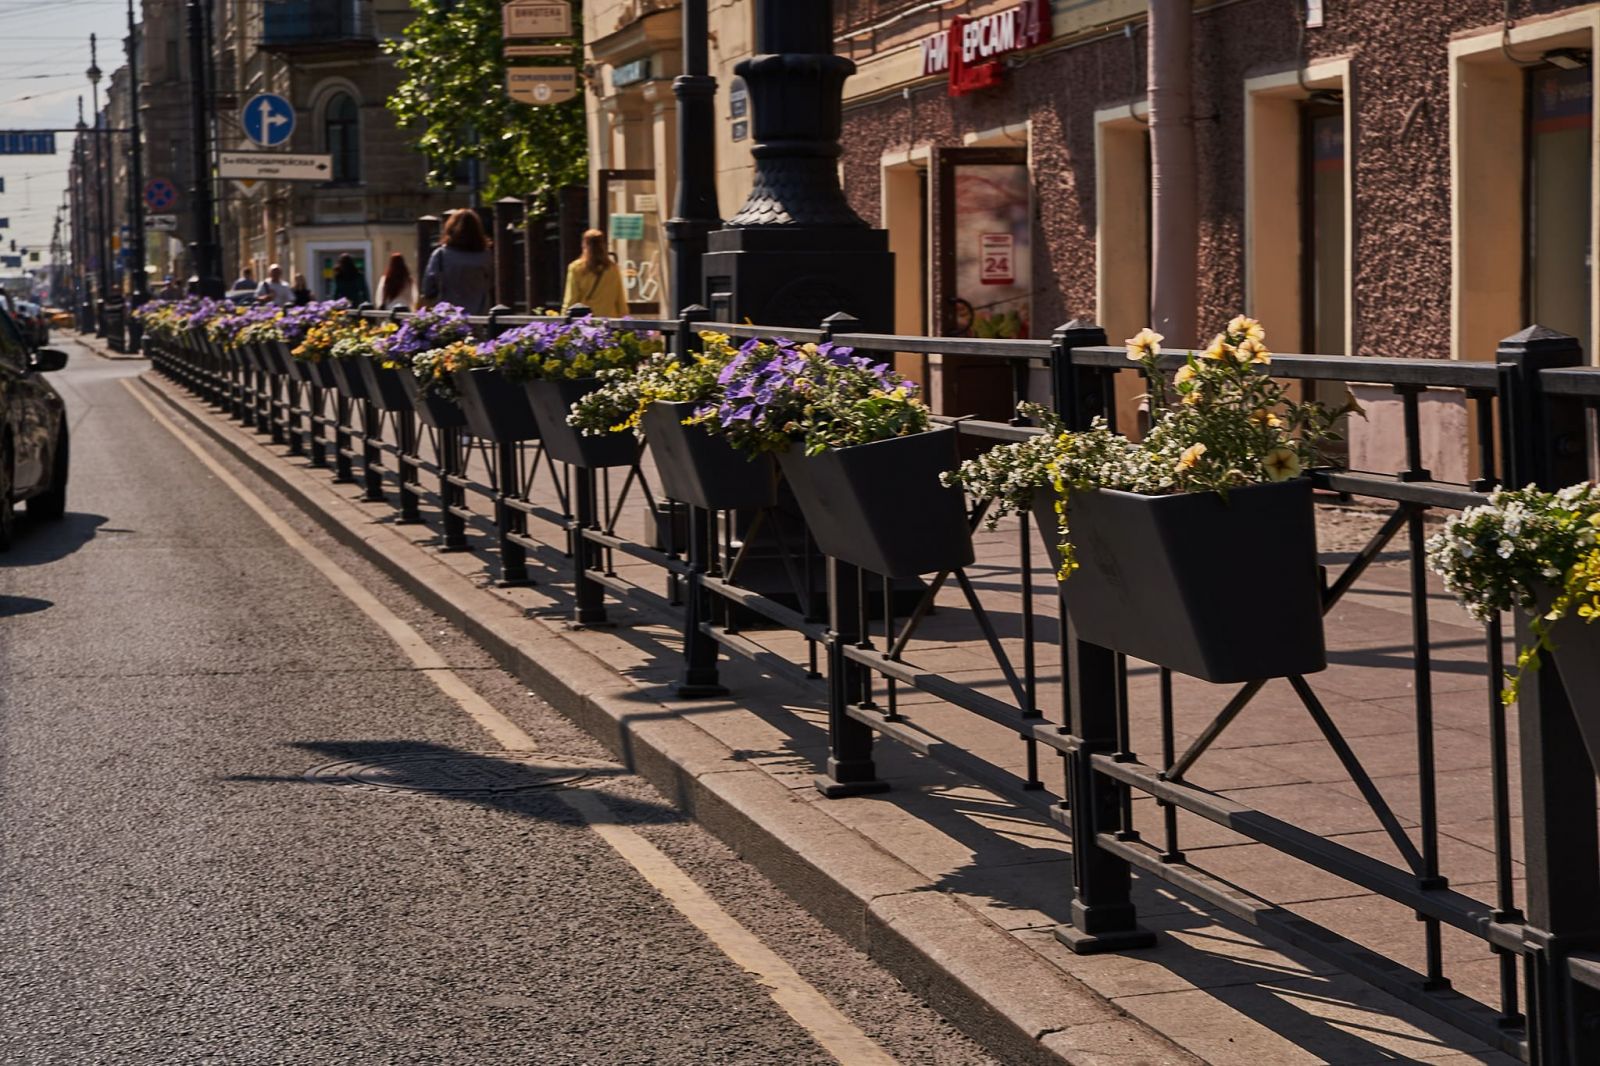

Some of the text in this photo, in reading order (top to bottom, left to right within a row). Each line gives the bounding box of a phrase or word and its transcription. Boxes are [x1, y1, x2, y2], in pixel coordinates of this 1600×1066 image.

[515, 8, 562, 17] ВИНОТЕКА
[918, 8, 1015, 75] УНИЕРСАМ
[985, 257, 1009, 272] 24
